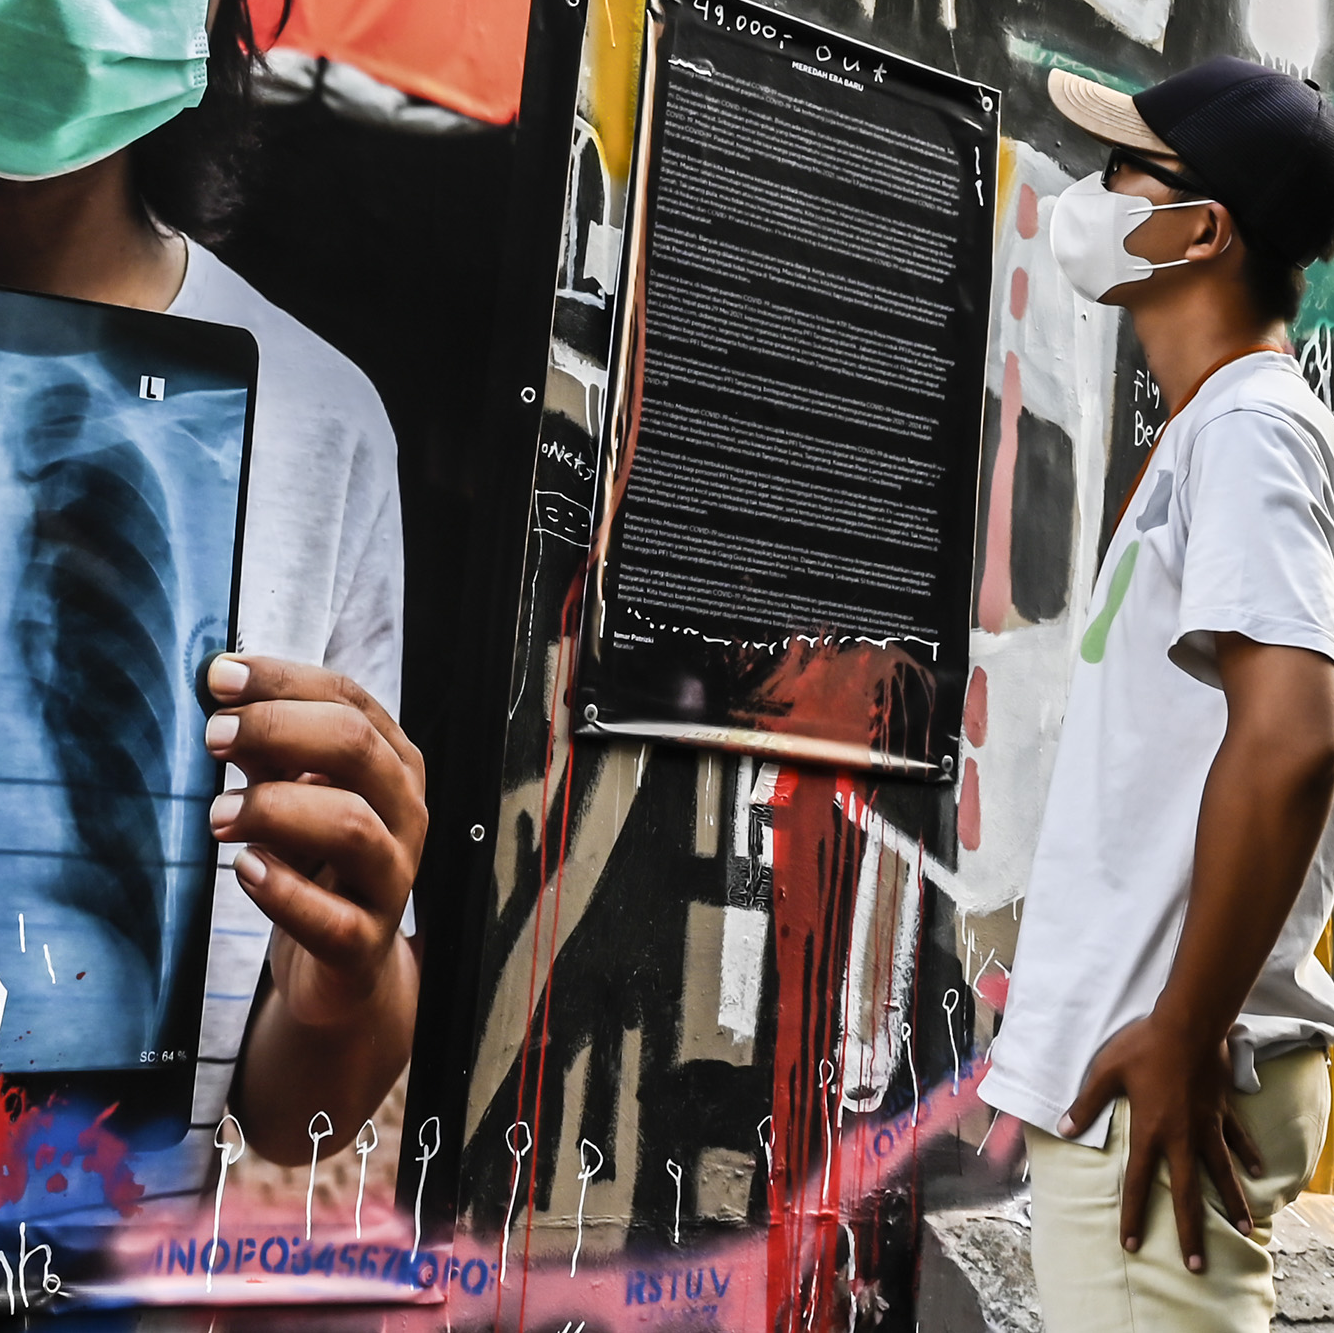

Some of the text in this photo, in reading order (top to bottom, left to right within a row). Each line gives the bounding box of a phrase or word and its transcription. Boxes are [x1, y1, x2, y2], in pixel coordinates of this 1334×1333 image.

[791, 60, 864, 92] MEREDAH ERA BARU
[1133, 369, 1160, 409] Fly
[161, 1050, 174, 1062] 64
[625, 1266, 732, 1306] RSTUV
